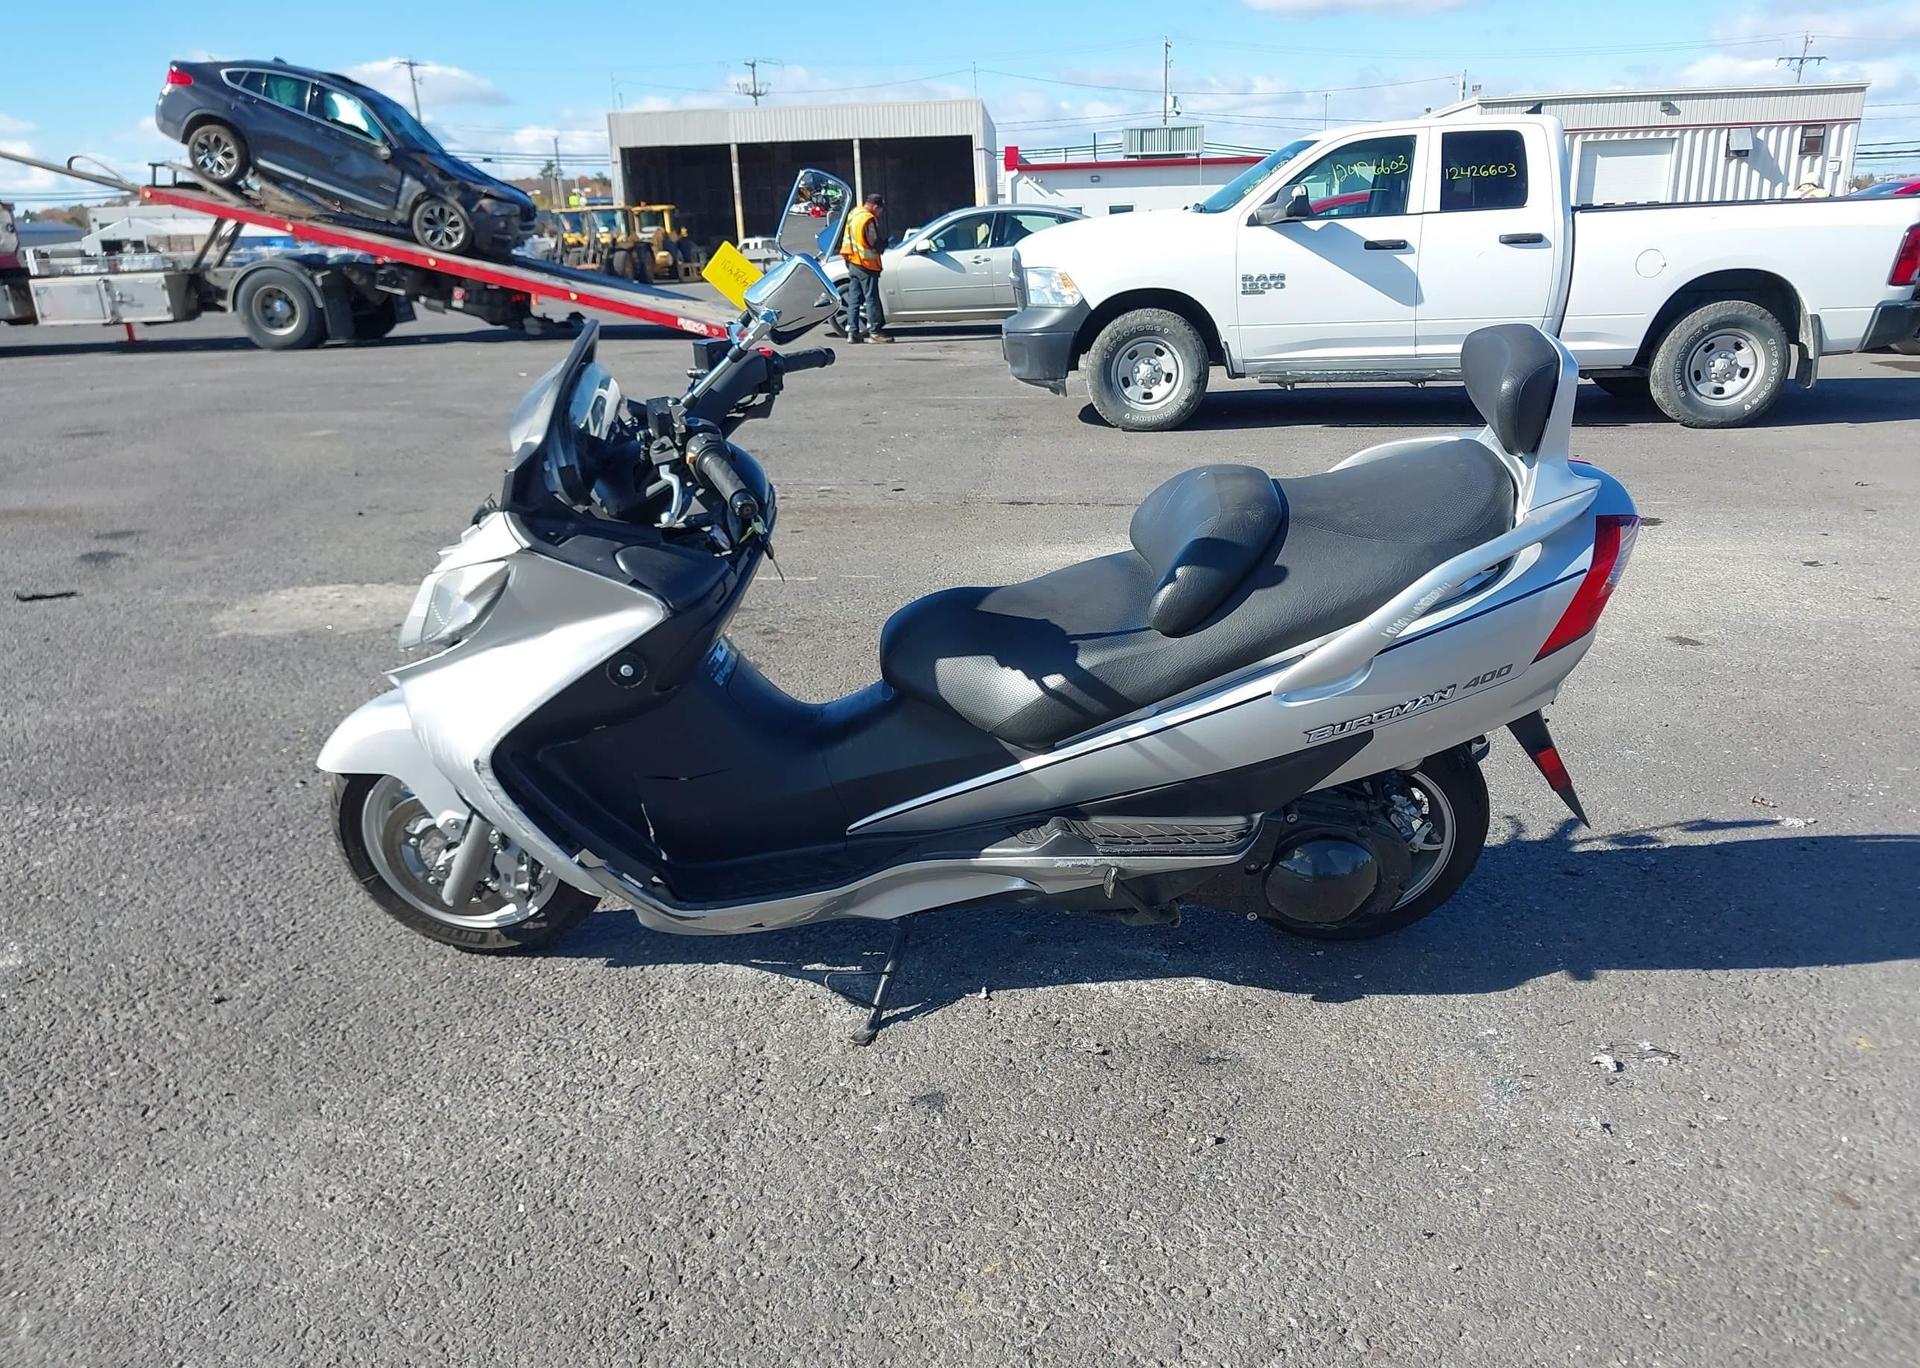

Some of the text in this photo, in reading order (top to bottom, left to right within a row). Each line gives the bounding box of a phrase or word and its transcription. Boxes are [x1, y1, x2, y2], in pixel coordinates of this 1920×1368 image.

[1445, 163, 1517, 180] 12426603
[1241, 273, 1286, 282] RAM
[1241, 282, 1286, 290] 1500
[1303, 663, 1514, 744] BURGMAN 400
